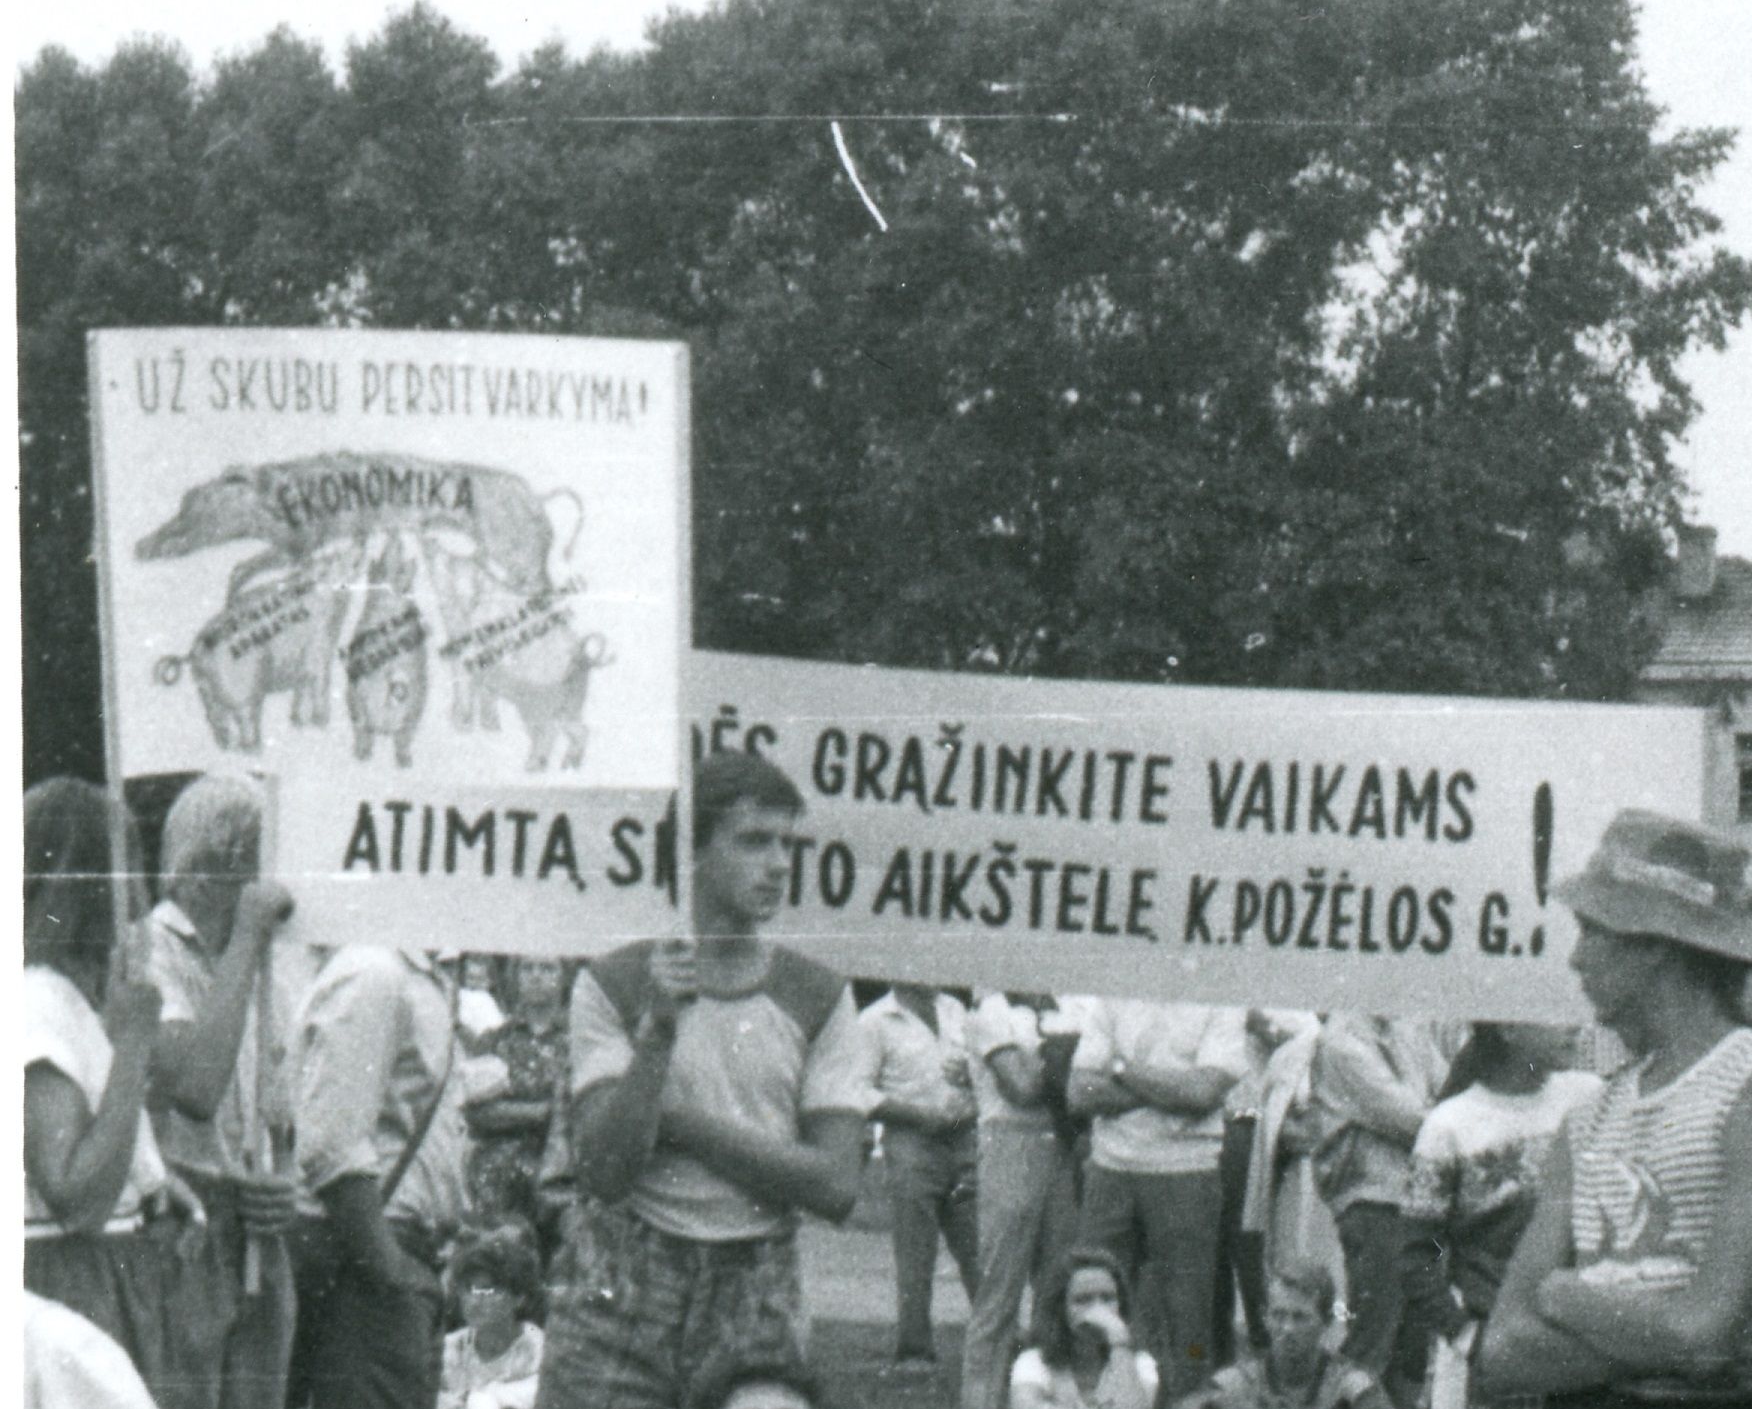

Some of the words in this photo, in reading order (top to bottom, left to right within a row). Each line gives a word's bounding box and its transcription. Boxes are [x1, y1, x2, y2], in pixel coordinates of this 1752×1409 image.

[135, 348, 187, 415] UŽ
[277, 467, 475, 527] EKONOMIKA
[1207, 758, 1477, 844] VAIKAMS
[343, 801, 587, 892] ATIMTĄ
[873, 841, 1159, 943] AIKŠTELĘ
